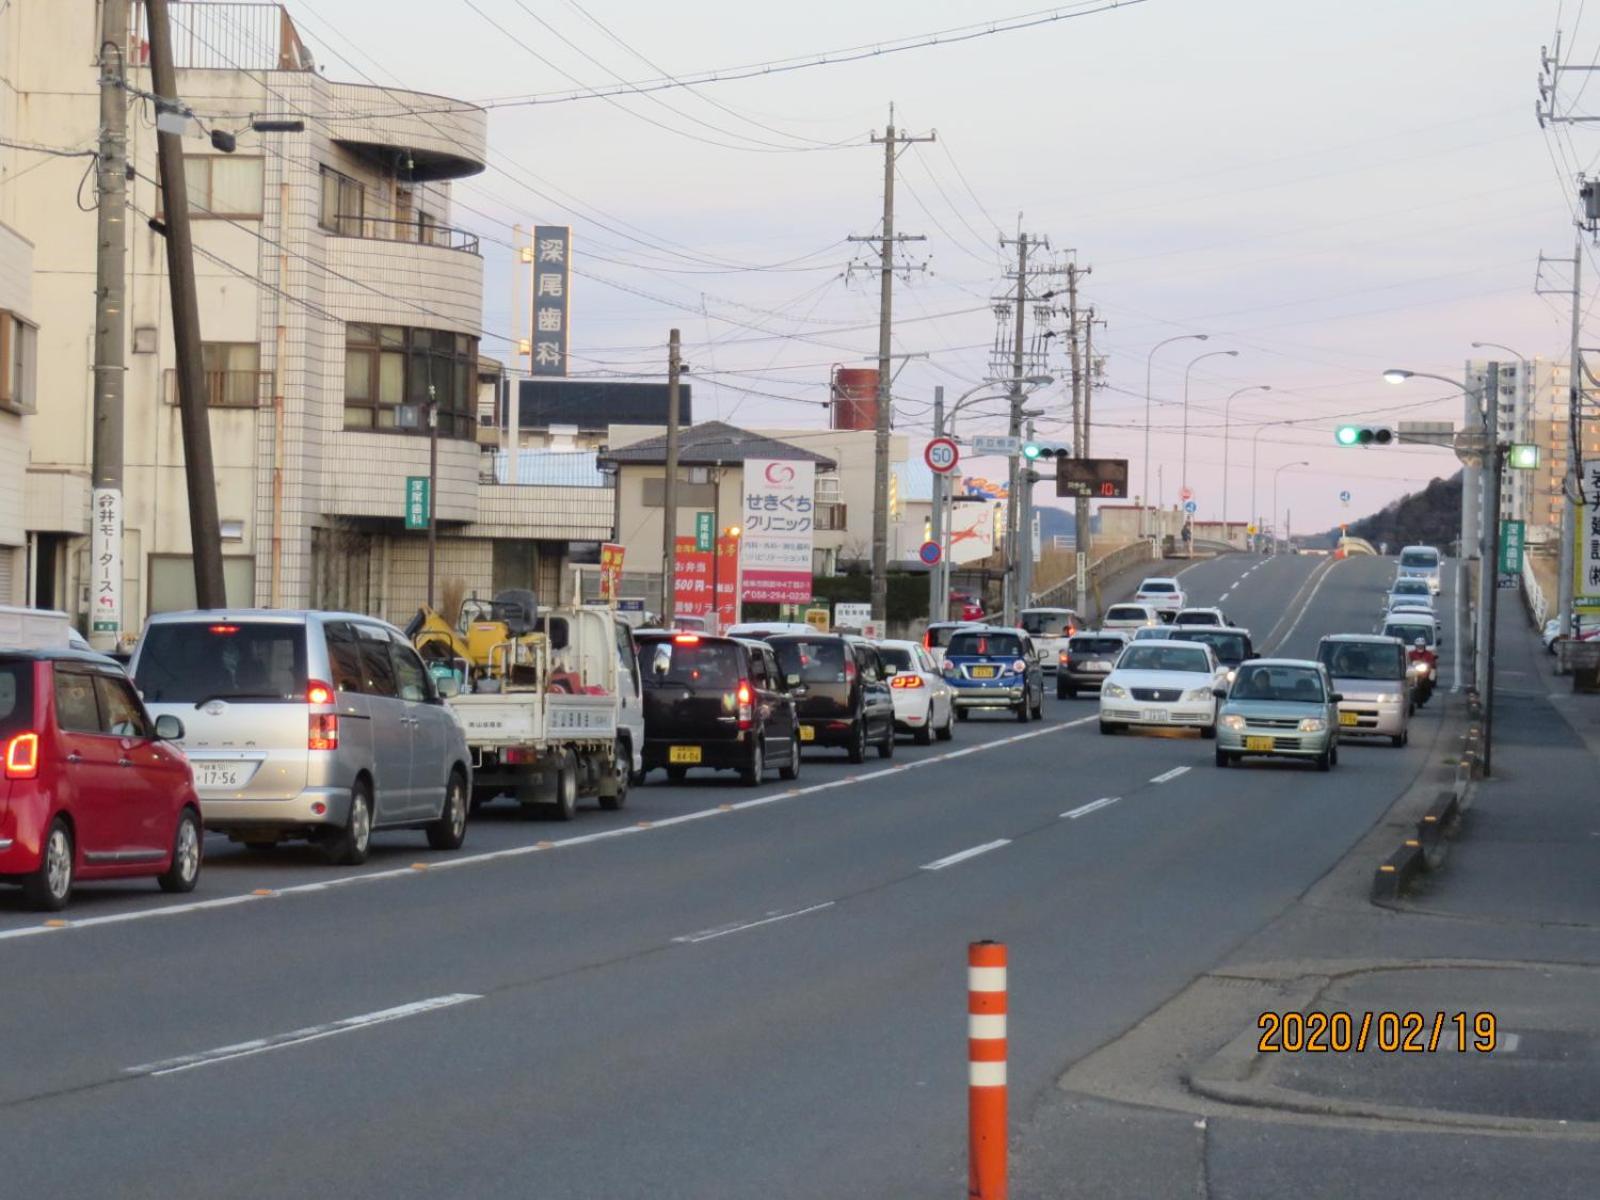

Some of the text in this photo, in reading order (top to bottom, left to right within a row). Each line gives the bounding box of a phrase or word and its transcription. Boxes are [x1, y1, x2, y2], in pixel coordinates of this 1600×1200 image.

[536, 238, 564, 367] 深尾歯科
[932, 447, 952, 463] 50
[746, 494, 812, 512] せきぐち
[745, 515, 812, 532] クリニック
